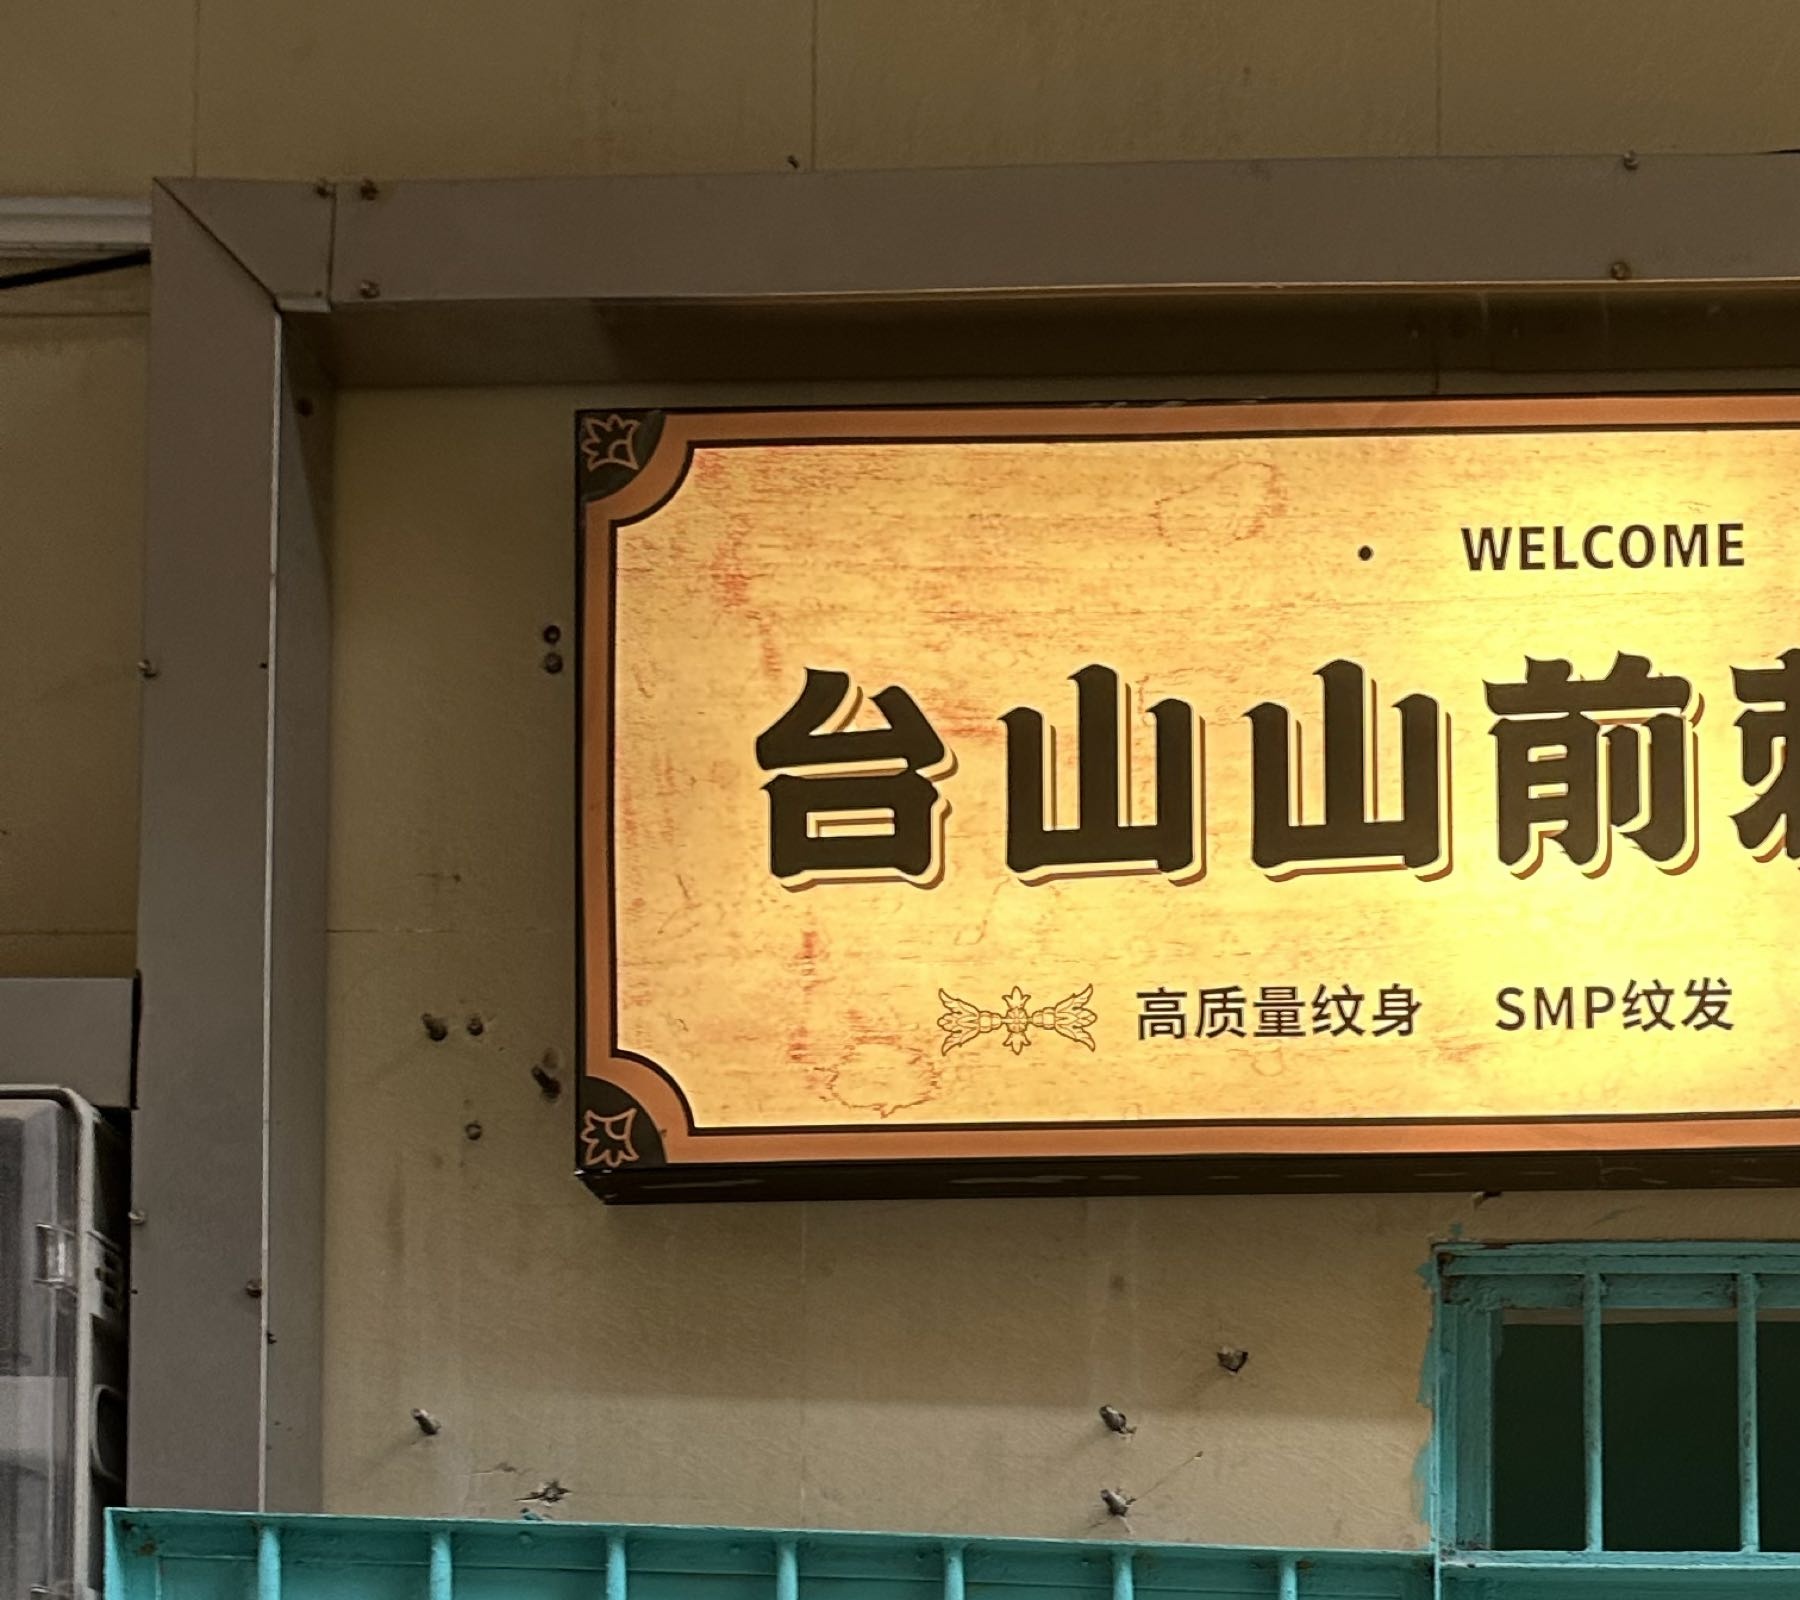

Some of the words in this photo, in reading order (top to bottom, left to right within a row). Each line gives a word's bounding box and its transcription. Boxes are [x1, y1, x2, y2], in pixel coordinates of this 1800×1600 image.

[1460, 522, 1746, 572] WELCOME
[1135, 982, 1423, 1042] 高质量纹身
[1495, 976, 1735, 1033] SMP纹发
